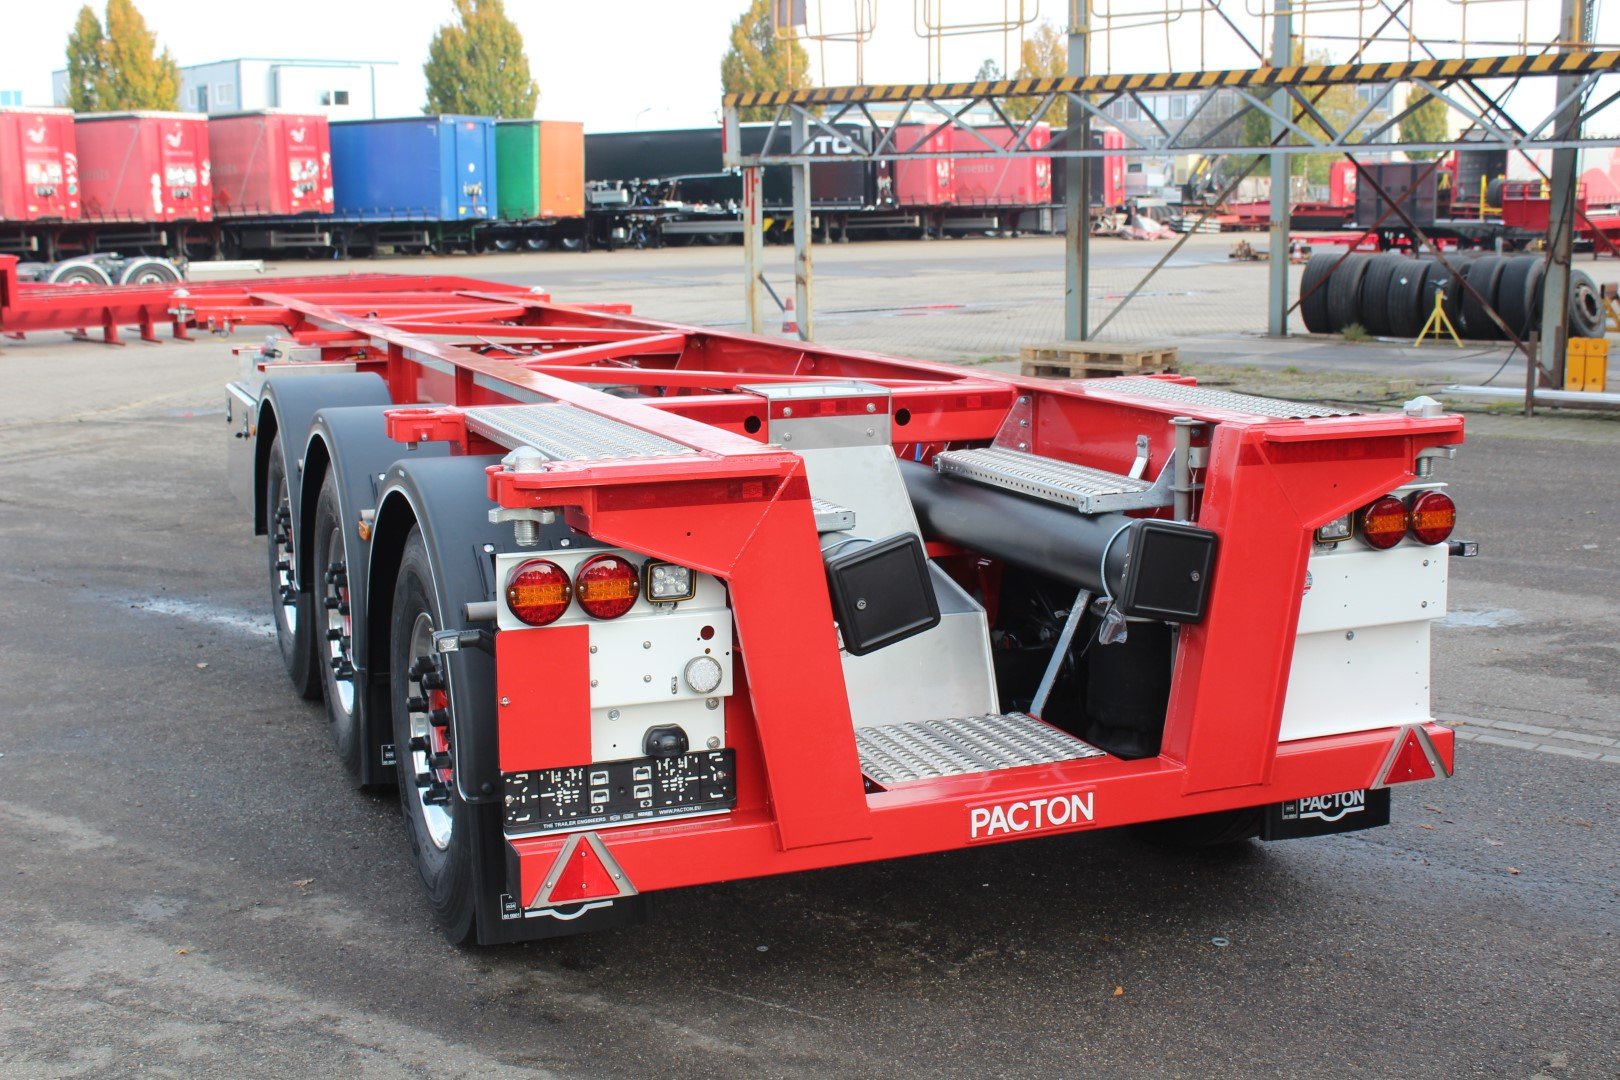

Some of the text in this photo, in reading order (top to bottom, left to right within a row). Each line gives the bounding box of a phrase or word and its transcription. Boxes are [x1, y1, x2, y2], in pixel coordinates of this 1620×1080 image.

[1300, 789, 1365, 812] PACTON
[555, 820, 577, 828] TRAILER
[577, 817, 607, 825] ENGINEERS
[659, 805, 702, 815] WWW.PACTON.EU
[971, 792, 1094, 838] PACTON
